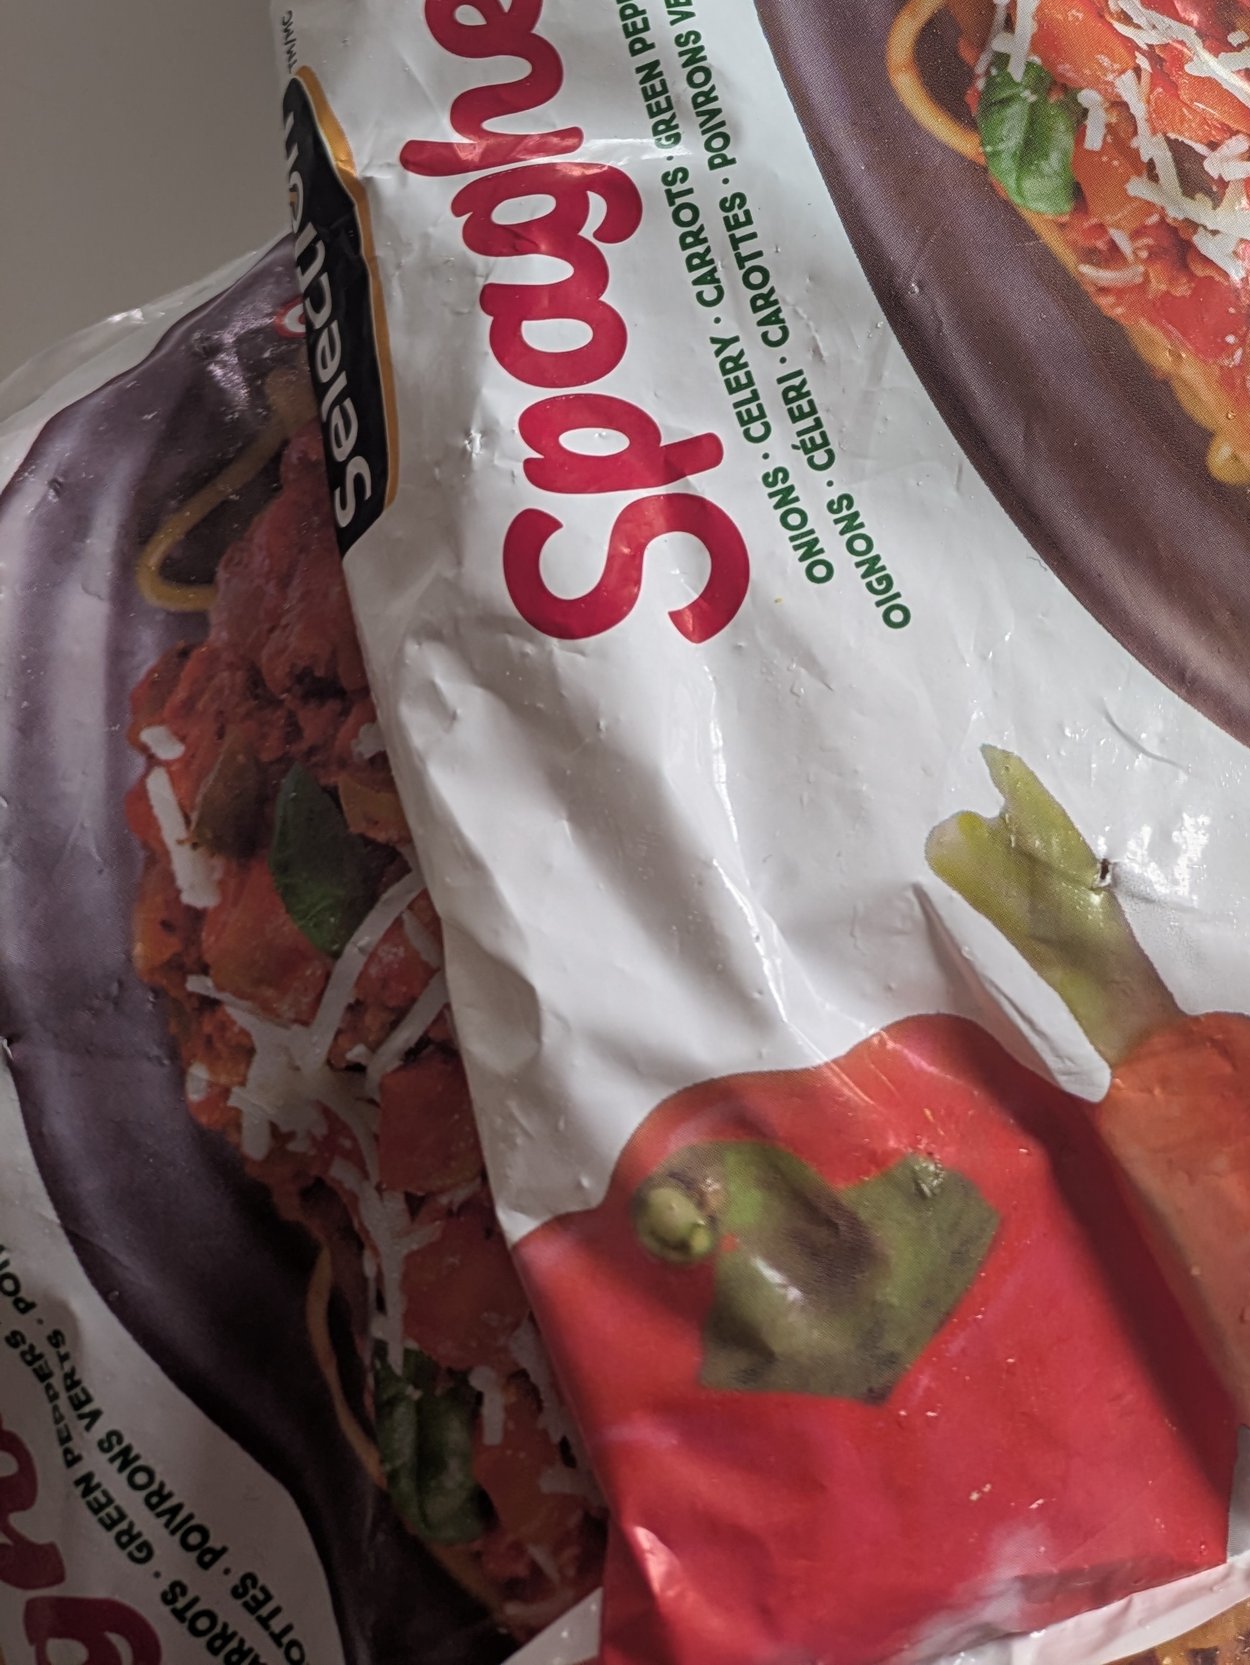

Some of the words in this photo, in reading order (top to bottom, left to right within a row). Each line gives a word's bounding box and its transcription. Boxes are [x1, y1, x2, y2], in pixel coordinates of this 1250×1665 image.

[635, 62, 682, 151] GREEN
[673, 30, 736, 171] POIVRONS
[661, 166, 725, 308] CARROTS
[718, 191, 790, 348] CAROTTES
[709, 335, 772, 444] CELERY
[776, 369, 836, 473] CÉLERI
[761, 465, 834, 584] ONIONS
[826, 492, 911, 630] OIGNONS
[5, 1329, 82, 1468] PEPPERS
[48, 1329, 103, 1432] VERTS
[74, 1471, 155, 1564] GREEN
[97, 1428, 228, 1571] POIVRONS
